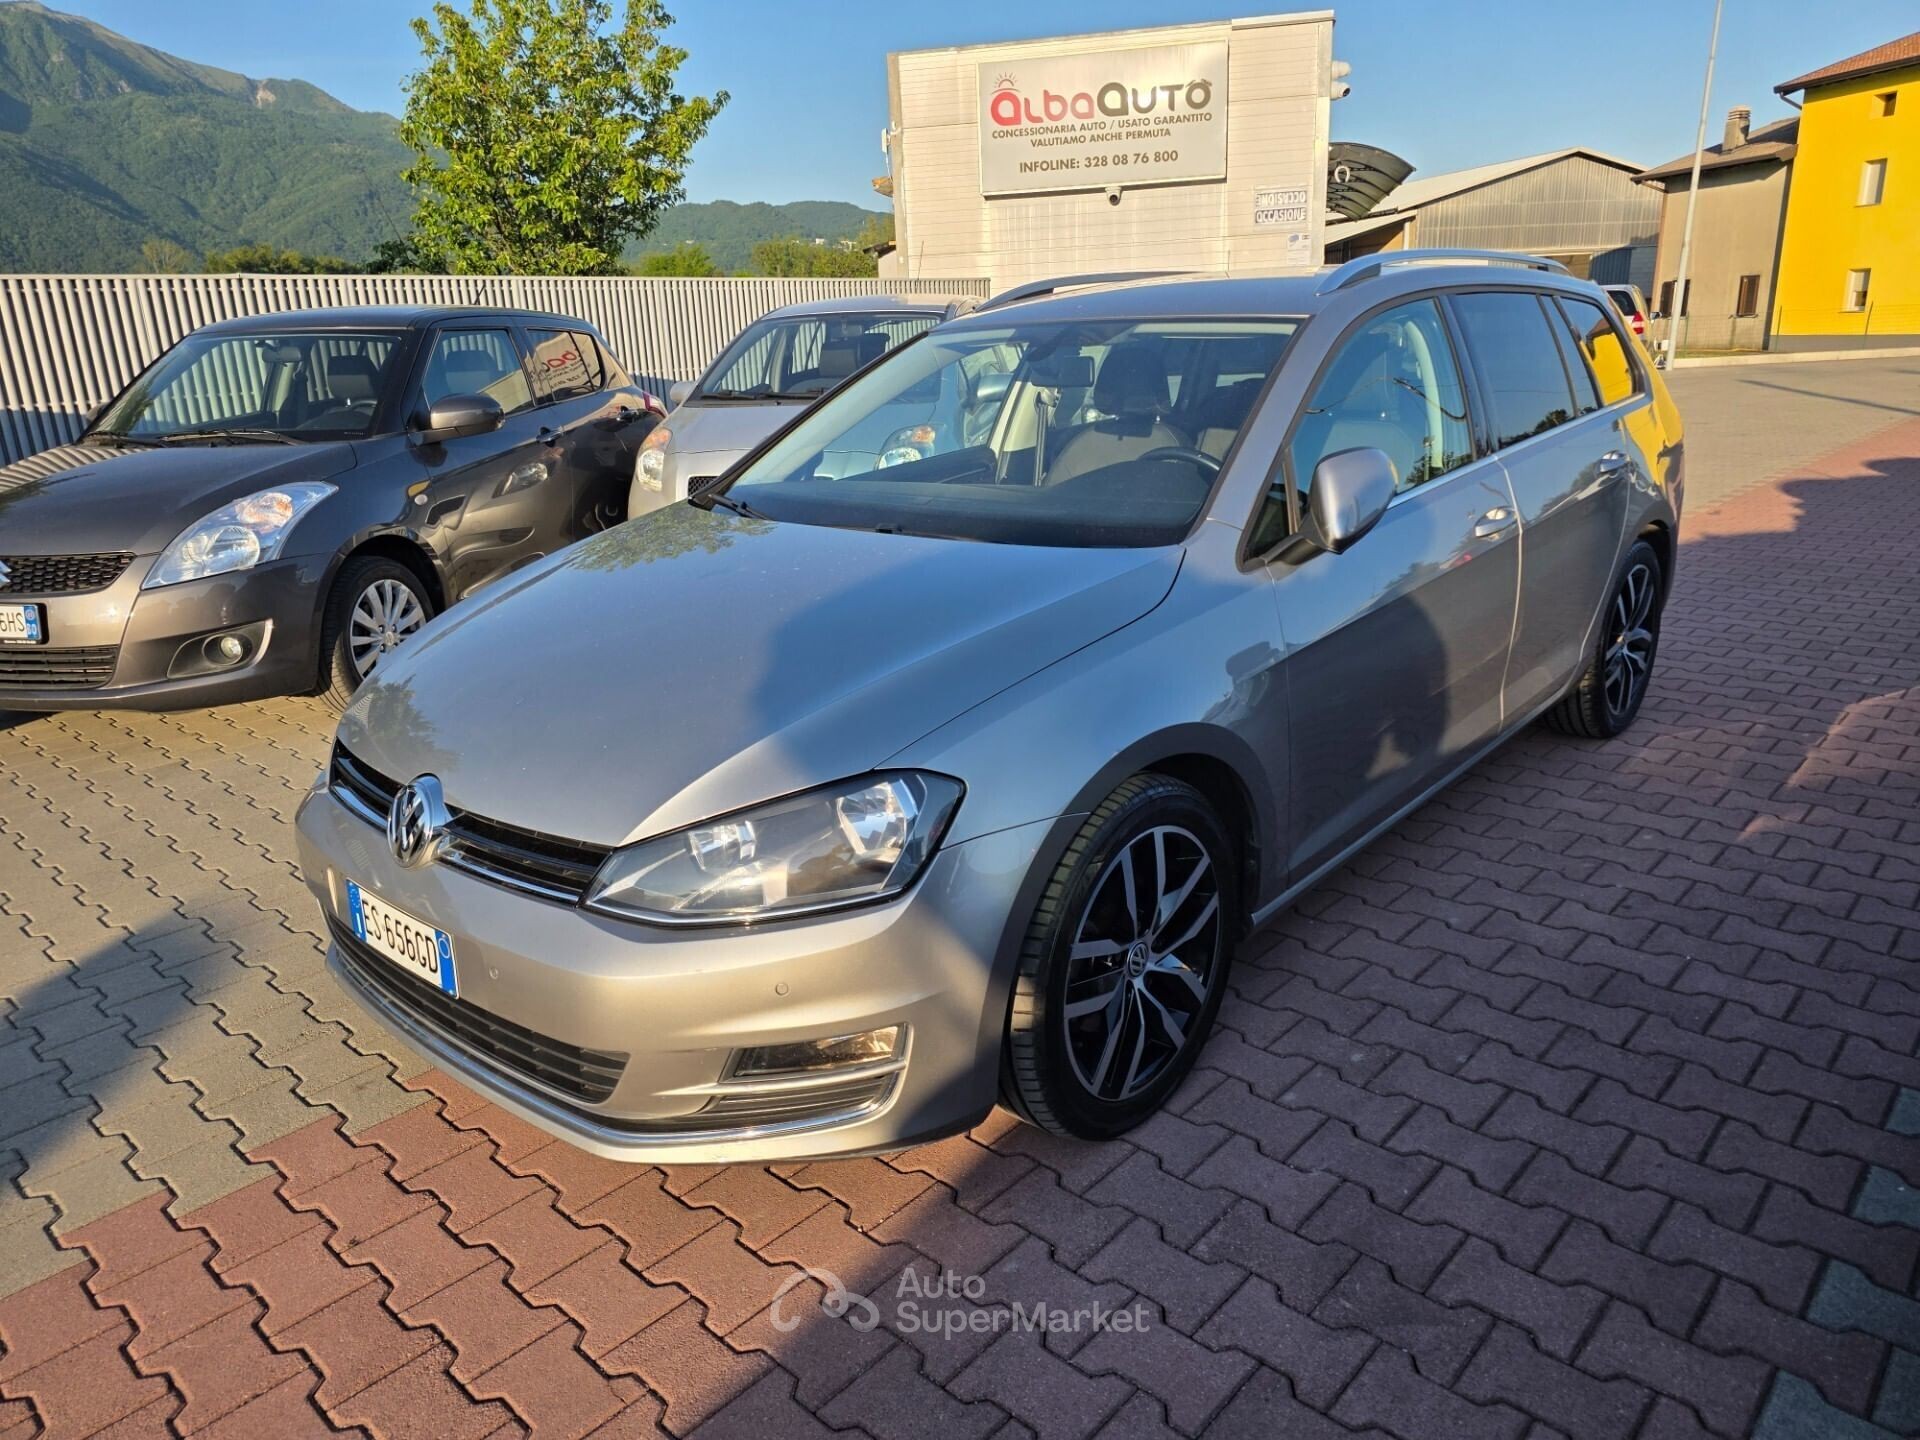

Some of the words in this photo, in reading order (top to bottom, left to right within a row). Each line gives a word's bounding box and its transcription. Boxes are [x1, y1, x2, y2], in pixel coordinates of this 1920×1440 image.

[992, 123, 1076, 139] CONCESSIONARIA
[1080, 121, 1107, 132] AUTO
[1118, 117, 1150, 129] USATO
[1153, 112, 1212, 126] GARANTITO
[1030, 135, 1086, 148] VALUTIAMO
[1089, 132, 1123, 143] ANCHE
[1126, 128, 1171, 140] PERMUTA
[1019, 158, 1080, 173] INFOLINE:
[1084, 156, 1108, 168] 328
[1112, 154, 1129, 166] 08
[1133, 153, 1150, 165] 76
[1153, 150, 1178, 163] 800
[1256, 207, 1306, 223] OCCASIONE
[362, 899, 382, 941] ES
